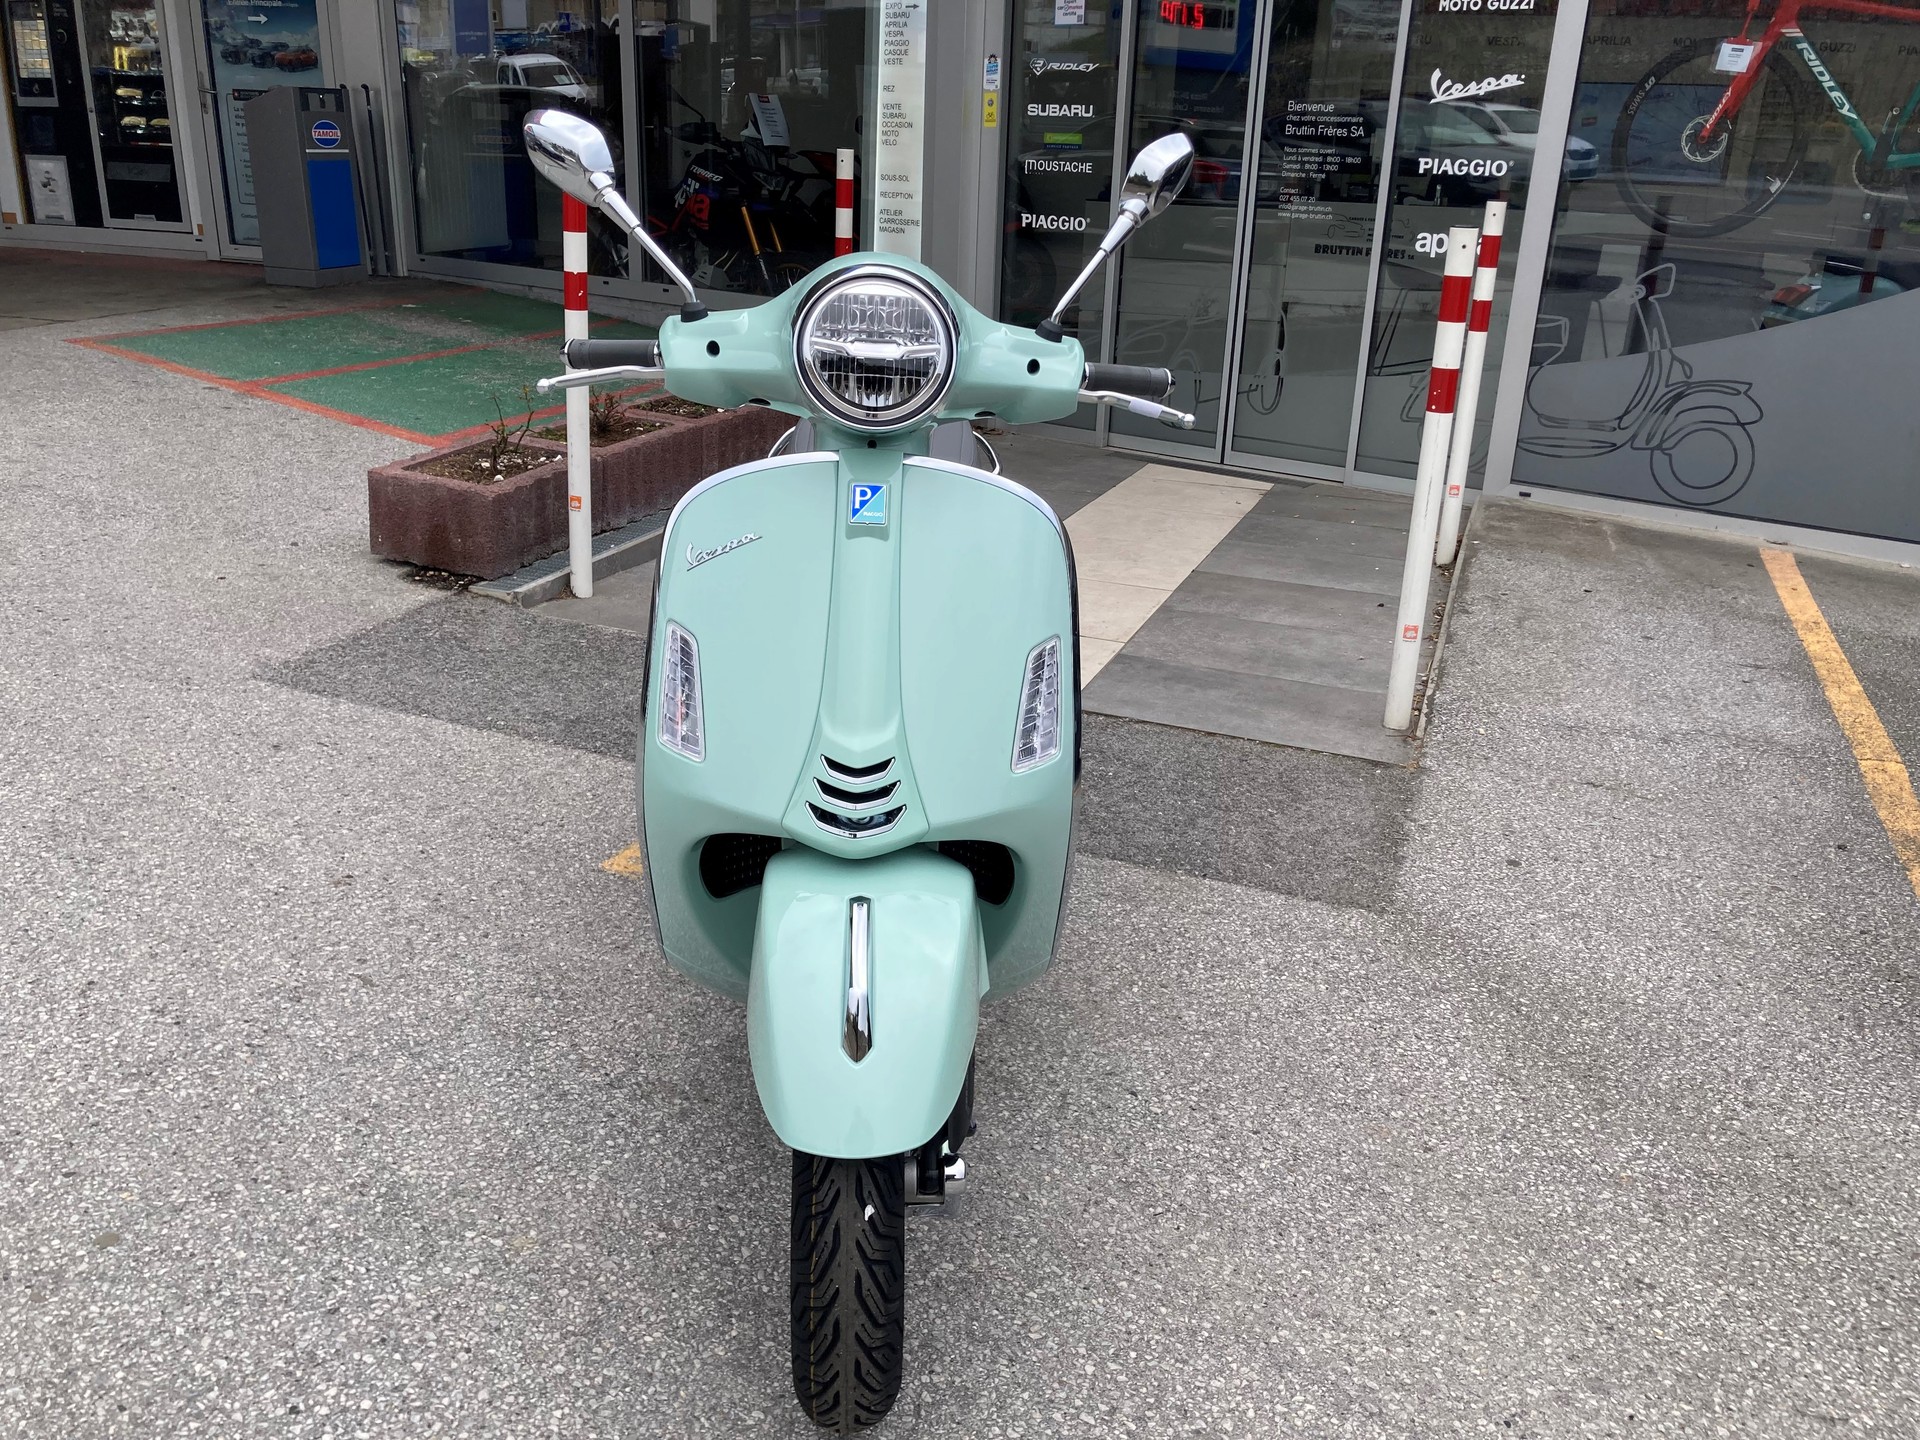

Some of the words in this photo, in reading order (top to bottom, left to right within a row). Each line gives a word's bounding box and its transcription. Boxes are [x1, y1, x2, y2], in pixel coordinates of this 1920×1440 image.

[885, 2, 903, 10] EXPO
[1438, 0, 1481, 12] MOTO
[1486, 0, 1535, 10] GUZZI
[885, 11, 910, 19] SUBARU
[884, 30, 905, 38] VESPA
[884, 39, 910, 47] PIAGGIO
[1487, 36, 1527, 47] VESPA
[1585, 35, 1632, 46] APRILIA
[883, 48, 909, 57] CASQUE
[883, 57, 903, 65] VESTE
[1047, 62, 1100, 73] RIDLEY
[1644, 76, 1656, 91] DT
[1796, 42, 1858, 119] RIDLEY
[883, 85, 895, 93] REZ
[1429, 67, 1526, 105] Vespa
[882, 103, 902, 111] VENTE
[1287, 100, 1335, 112] Bienvenue
[1627, 91, 1645, 116] SWISS
[1706, 87, 1733, 129] RIDLEY
[1027, 103, 1094, 118] SUBARU
[882, 112, 907, 120] SUBARU
[1316, 115, 1364, 123] concessionnaire
[881, 121, 913, 129] OCCASION
[313, 130, 341, 138] TAMOIL
[1285, 124, 1316, 135] Bruttin
[1317, 125, 1348, 137] Frères
[1350, 126, 1365, 137] SA
[1025, 159, 1093, 174] MOUSTACHE
[1418, 157, 1508, 177] PIAGGIO
[880, 174, 910, 182] SOUS-SOL
[1280, 186, 1299, 194] Contact
[879, 191, 914, 200] RECEPTION
[879, 208, 903, 217] ATELIER
[879, 218, 920, 227] CARROSSERIE
[1021, 213, 1086, 231] PIAGGIO
[879, 226, 906, 234] MAGASIN
[1314, 244, 1363, 257] BRUTTIN
[854, 486, 872, 509] P
[685, 532, 763, 572] Vespa
